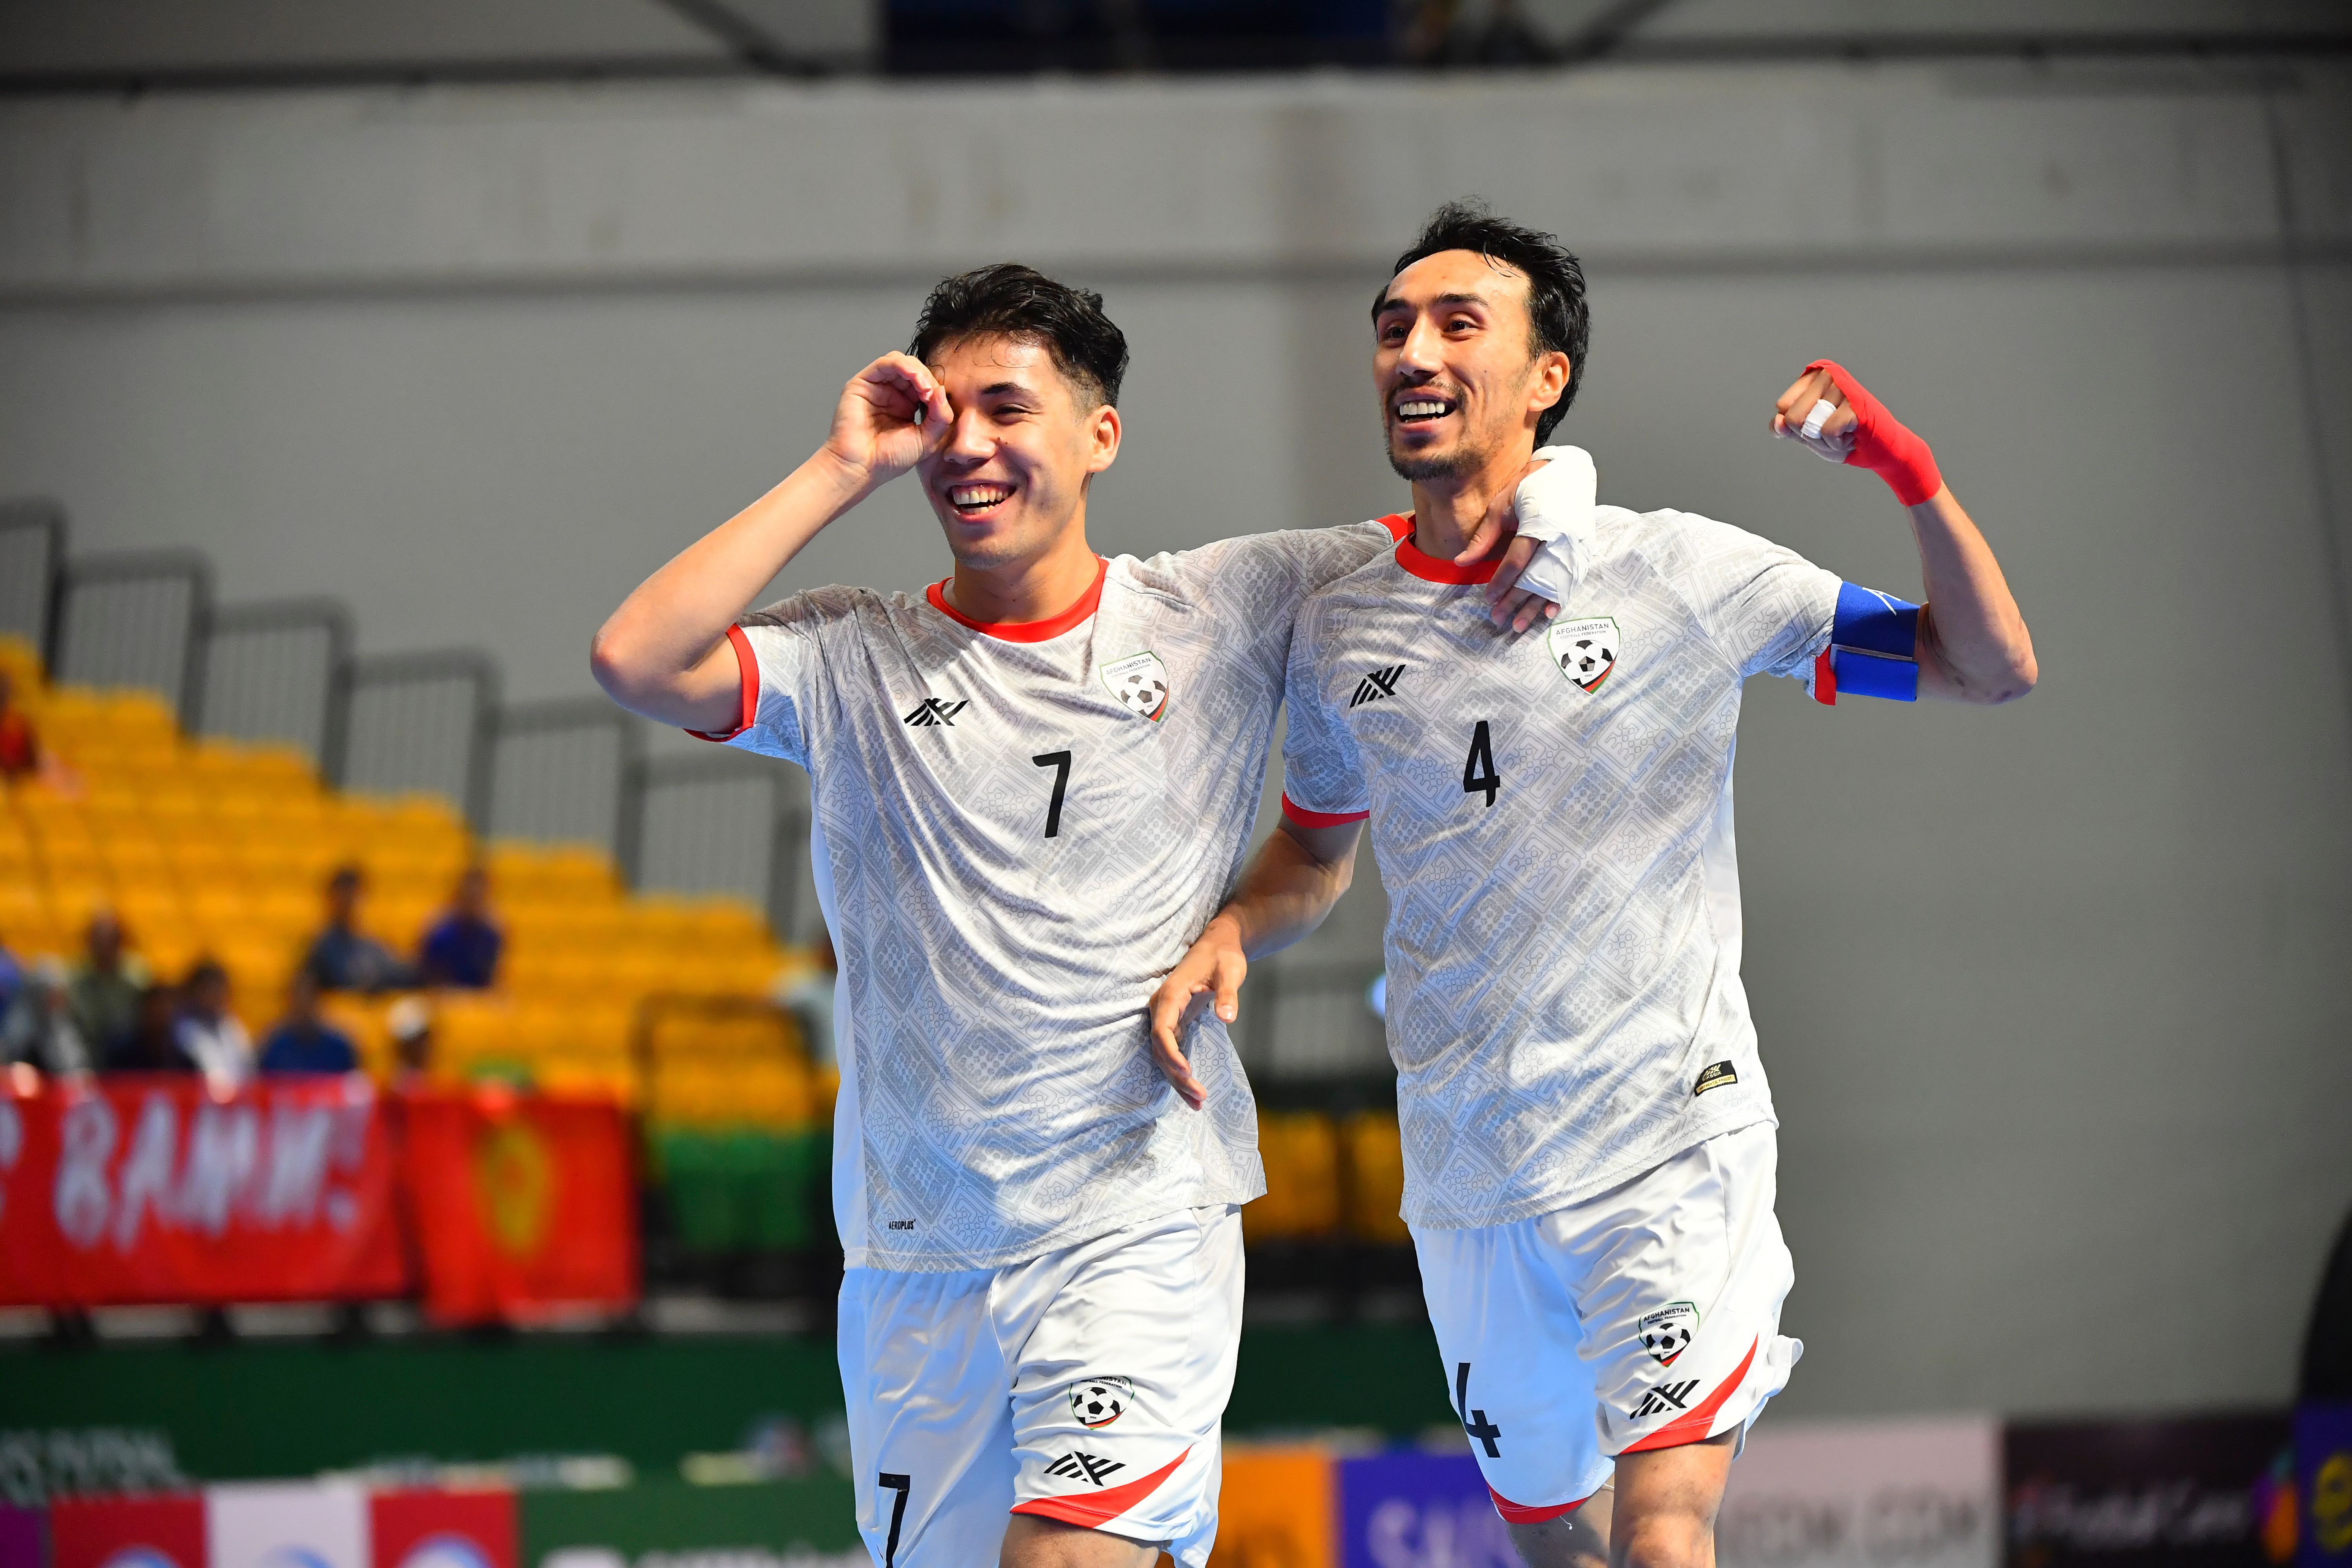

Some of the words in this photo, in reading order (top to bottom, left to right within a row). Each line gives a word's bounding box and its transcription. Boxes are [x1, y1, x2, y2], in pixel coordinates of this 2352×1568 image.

[1556, 623, 1609, 635] AFGHANISTAN
[1106, 657, 1151, 675] AFGHANISTAN
[1129, 664, 1150, 672] FEDERATION
[1463, 720, 1500, 808] 4
[1032, 750, 1071, 838] 7
[888, 1220, 914, 1230] AEROPLUS
[1644, 1307, 1690, 1322] AFGHANISTAN
[1099, 1380, 1122, 1389] FEDERATION
[1456, 1362, 1502, 1458] 4
[879, 1472, 910, 1568] 7
